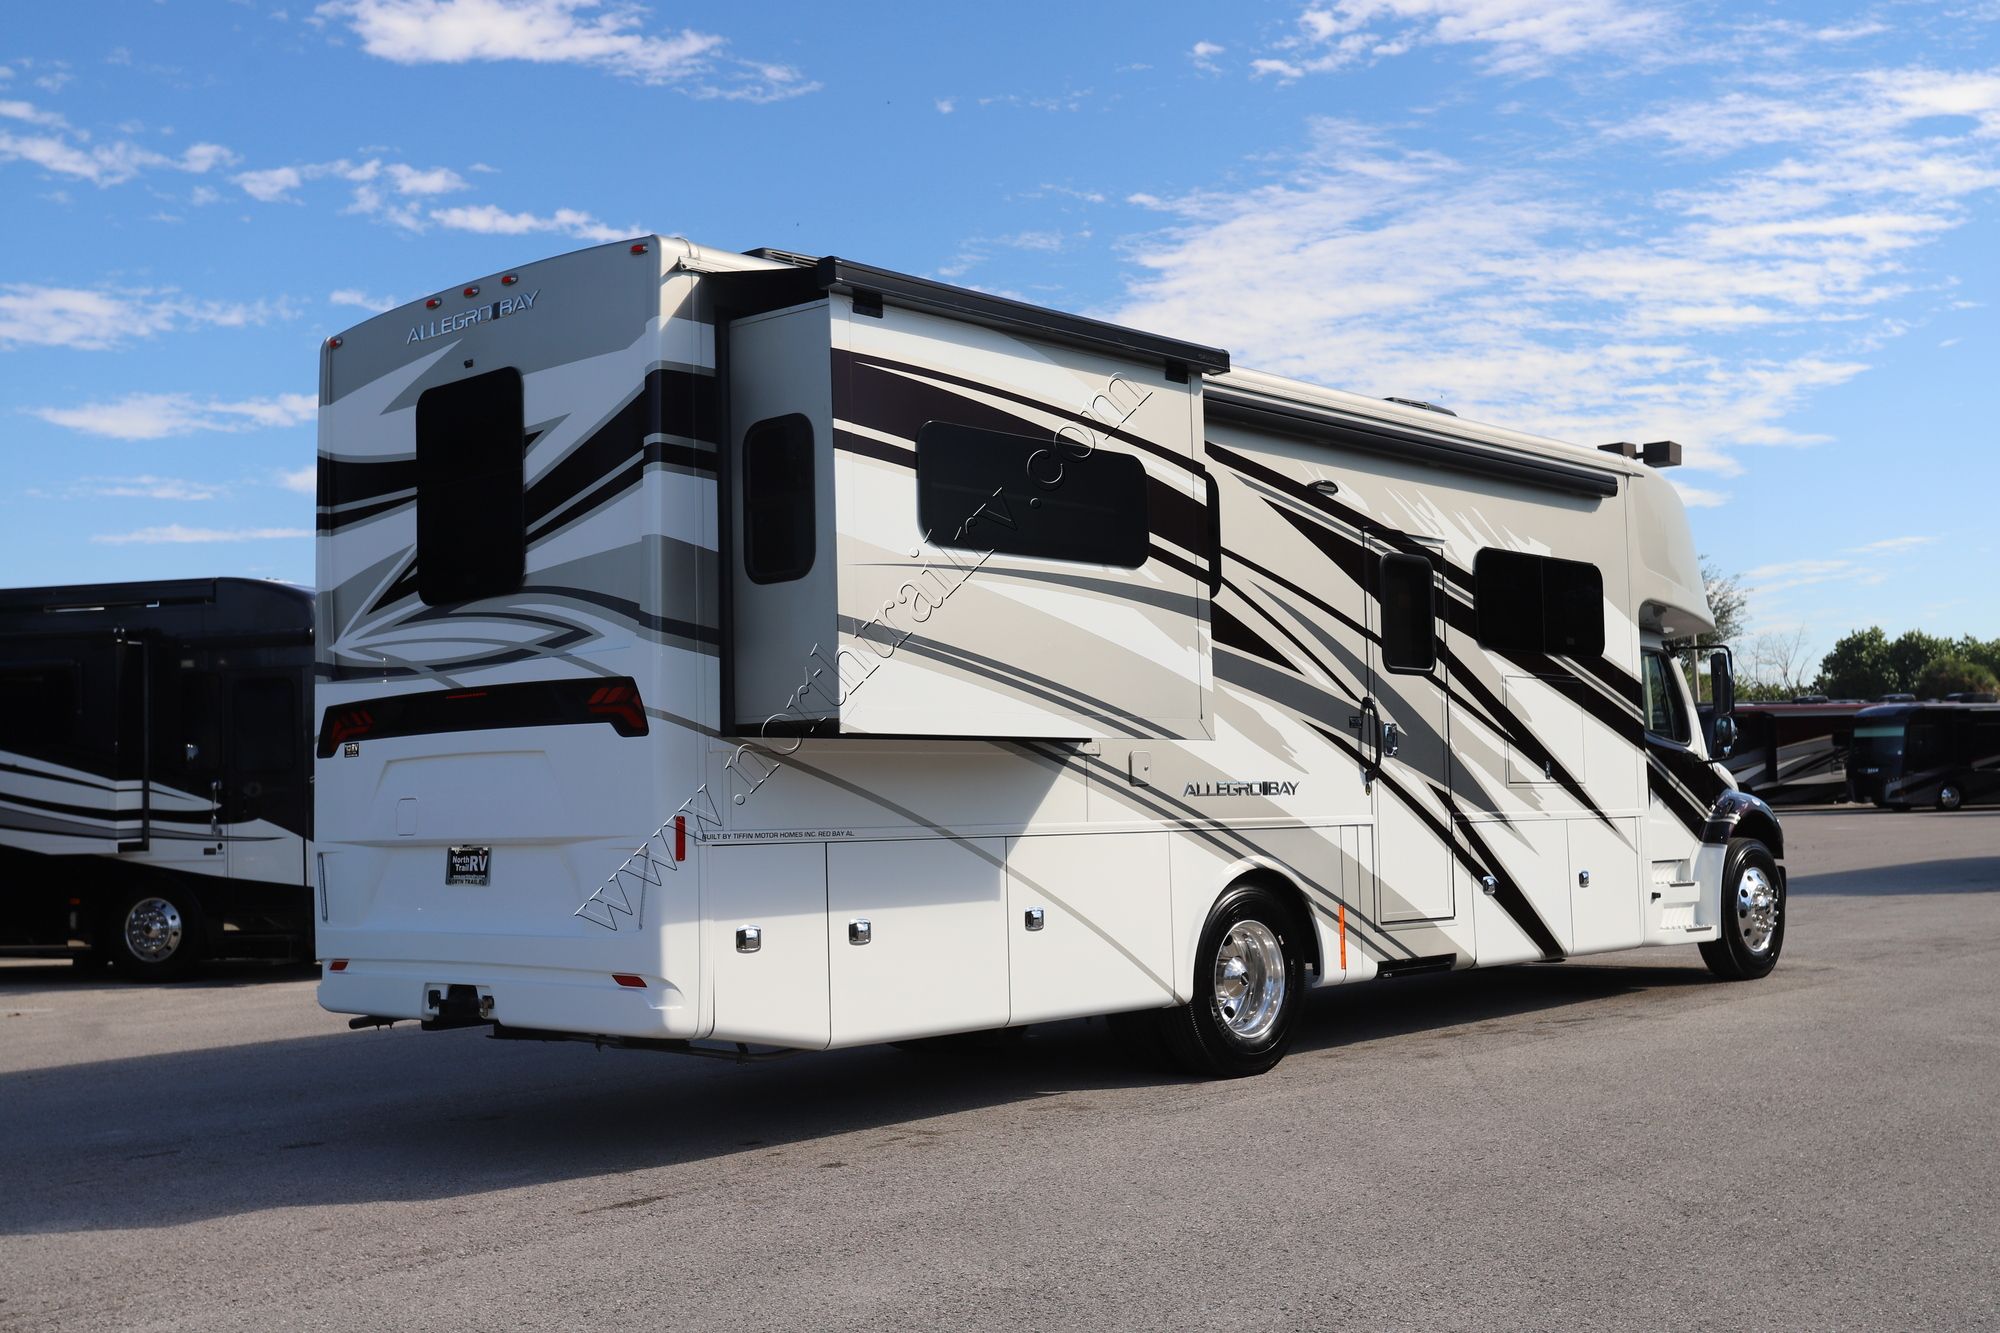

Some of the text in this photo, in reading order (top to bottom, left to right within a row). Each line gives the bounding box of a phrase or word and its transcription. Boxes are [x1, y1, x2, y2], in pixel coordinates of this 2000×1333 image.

[407, 289, 541, 345] ALLEGRO BAY
[1183, 781, 1300, 797] ALLEGRO BAY
[702, 833, 721, 841] BUILT
[734, 832, 754, 840] TIFFIN
[755, 831, 779, 839] MOTOR
[780, 831, 804, 839] HOMES
[818, 830, 831, 838] RED
[452, 855, 488, 872] North RV
